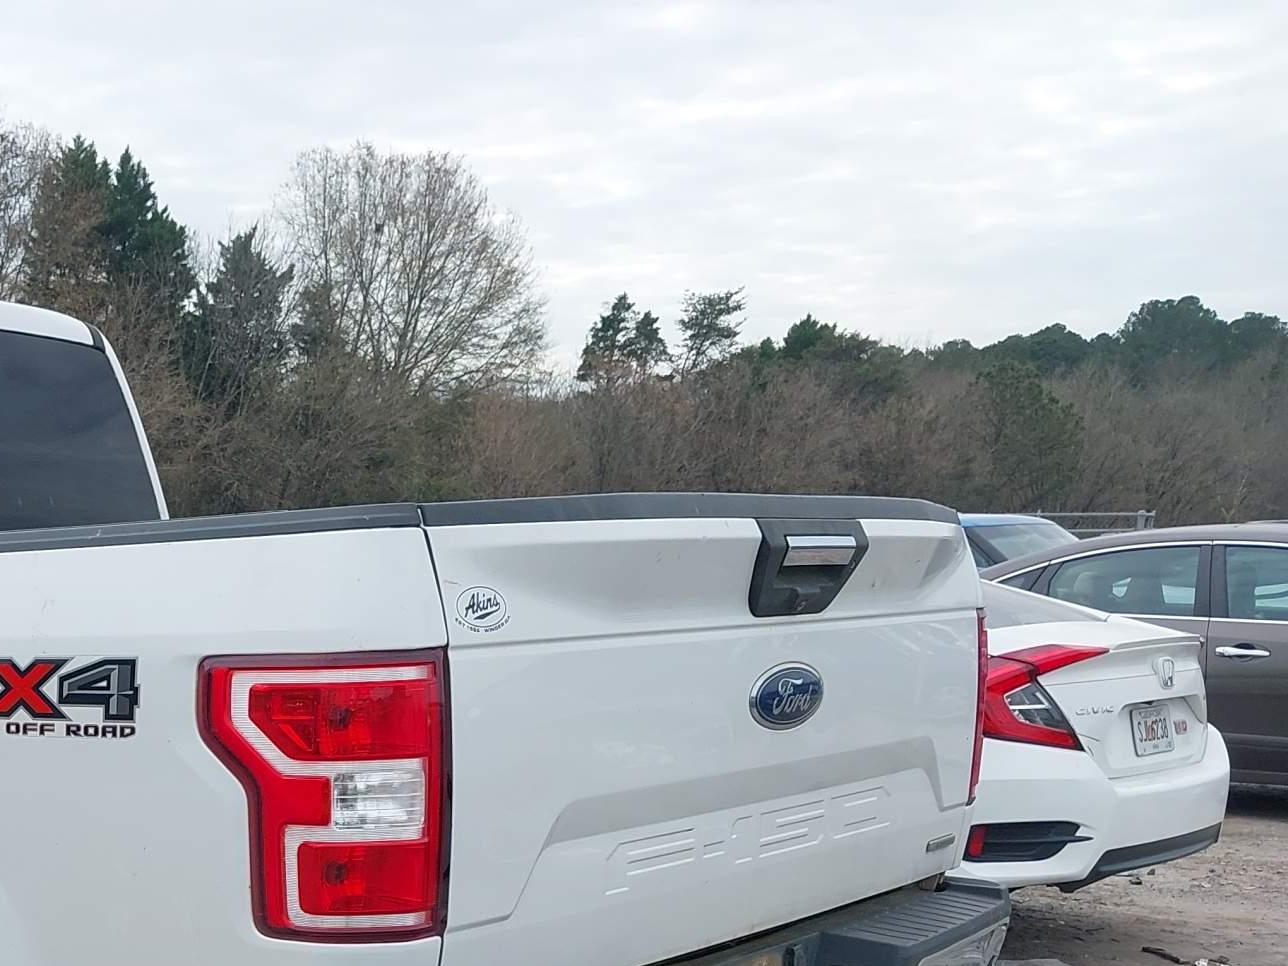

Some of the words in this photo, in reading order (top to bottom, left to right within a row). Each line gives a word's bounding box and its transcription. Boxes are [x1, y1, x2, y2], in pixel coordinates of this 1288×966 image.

[465, 592, 500, 617] Akins
[773, 678, 812, 715] Ford
[1075, 706, 1114, 716] CIVIC
[6, 722, 56, 736] OFF
[65, 723, 137, 738] ROAD
[605, 785, 891, 895] F-150
